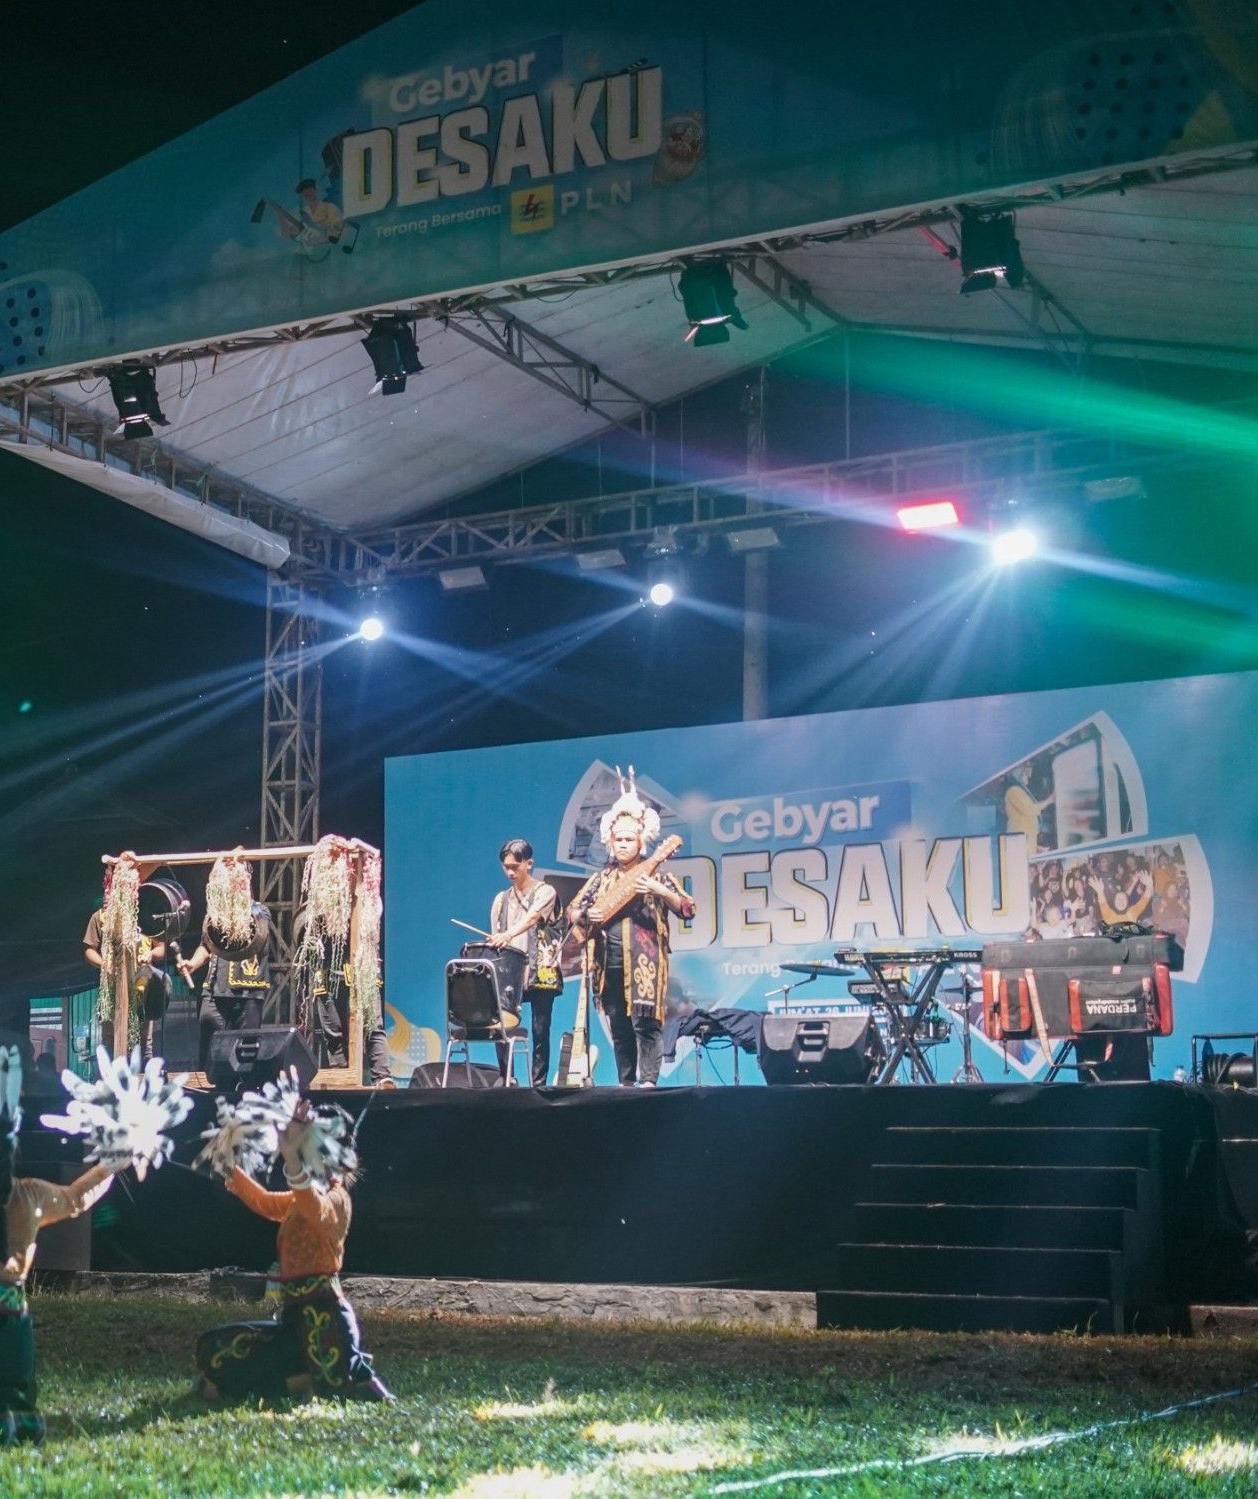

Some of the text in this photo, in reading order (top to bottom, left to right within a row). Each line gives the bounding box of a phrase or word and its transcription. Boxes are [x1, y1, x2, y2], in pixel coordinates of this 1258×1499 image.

[389, 52, 536, 113] Gebyar
[343, 66, 663, 219] DESAKU
[560, 180, 632, 216] PLN
[374, 203, 502, 240] Terang Bersama
[710, 794, 880, 844] Gebyar
[667, 833, 1031, 952] DESAKU
[722, 960, 782, 978] Terang
[1085, 1004, 1137, 1014] PERDANA
